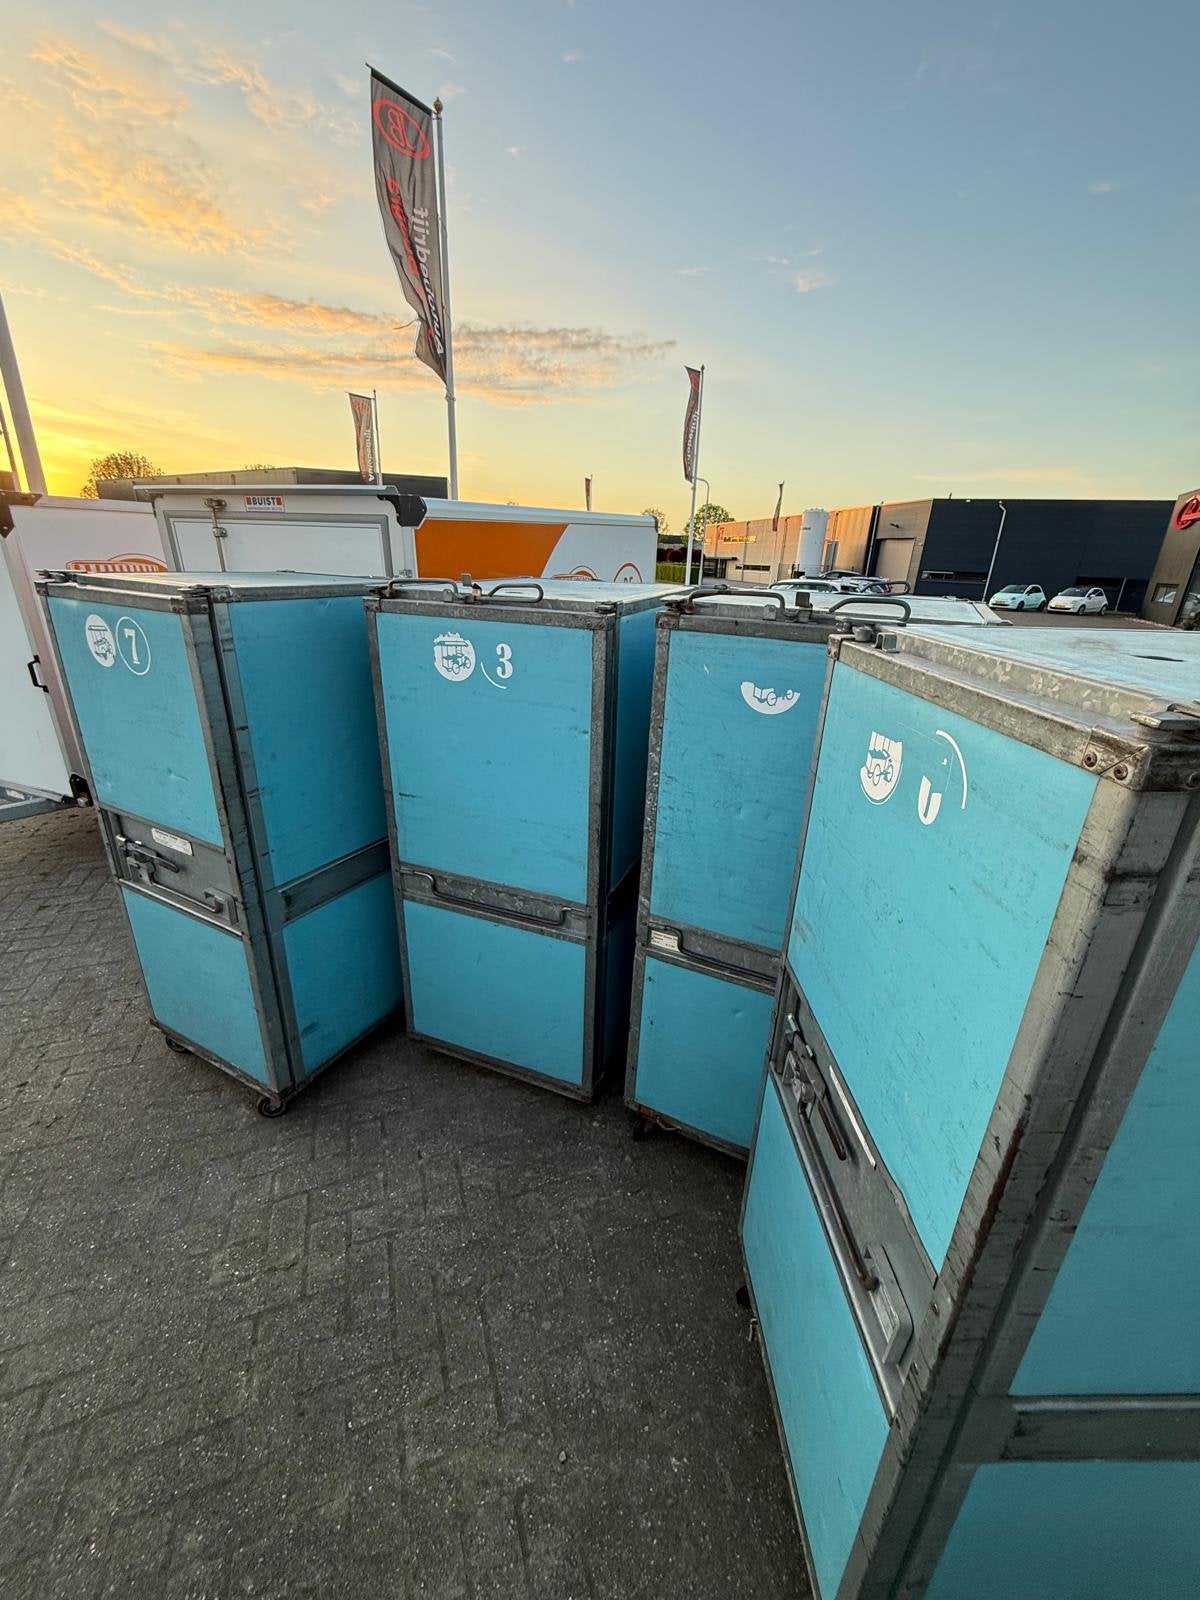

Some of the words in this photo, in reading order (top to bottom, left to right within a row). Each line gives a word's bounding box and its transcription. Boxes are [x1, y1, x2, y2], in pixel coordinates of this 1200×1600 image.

[252, 496, 276, 506] BUIST
[123, 628, 140, 665] 7
[496, 643, 514, 679] 3
